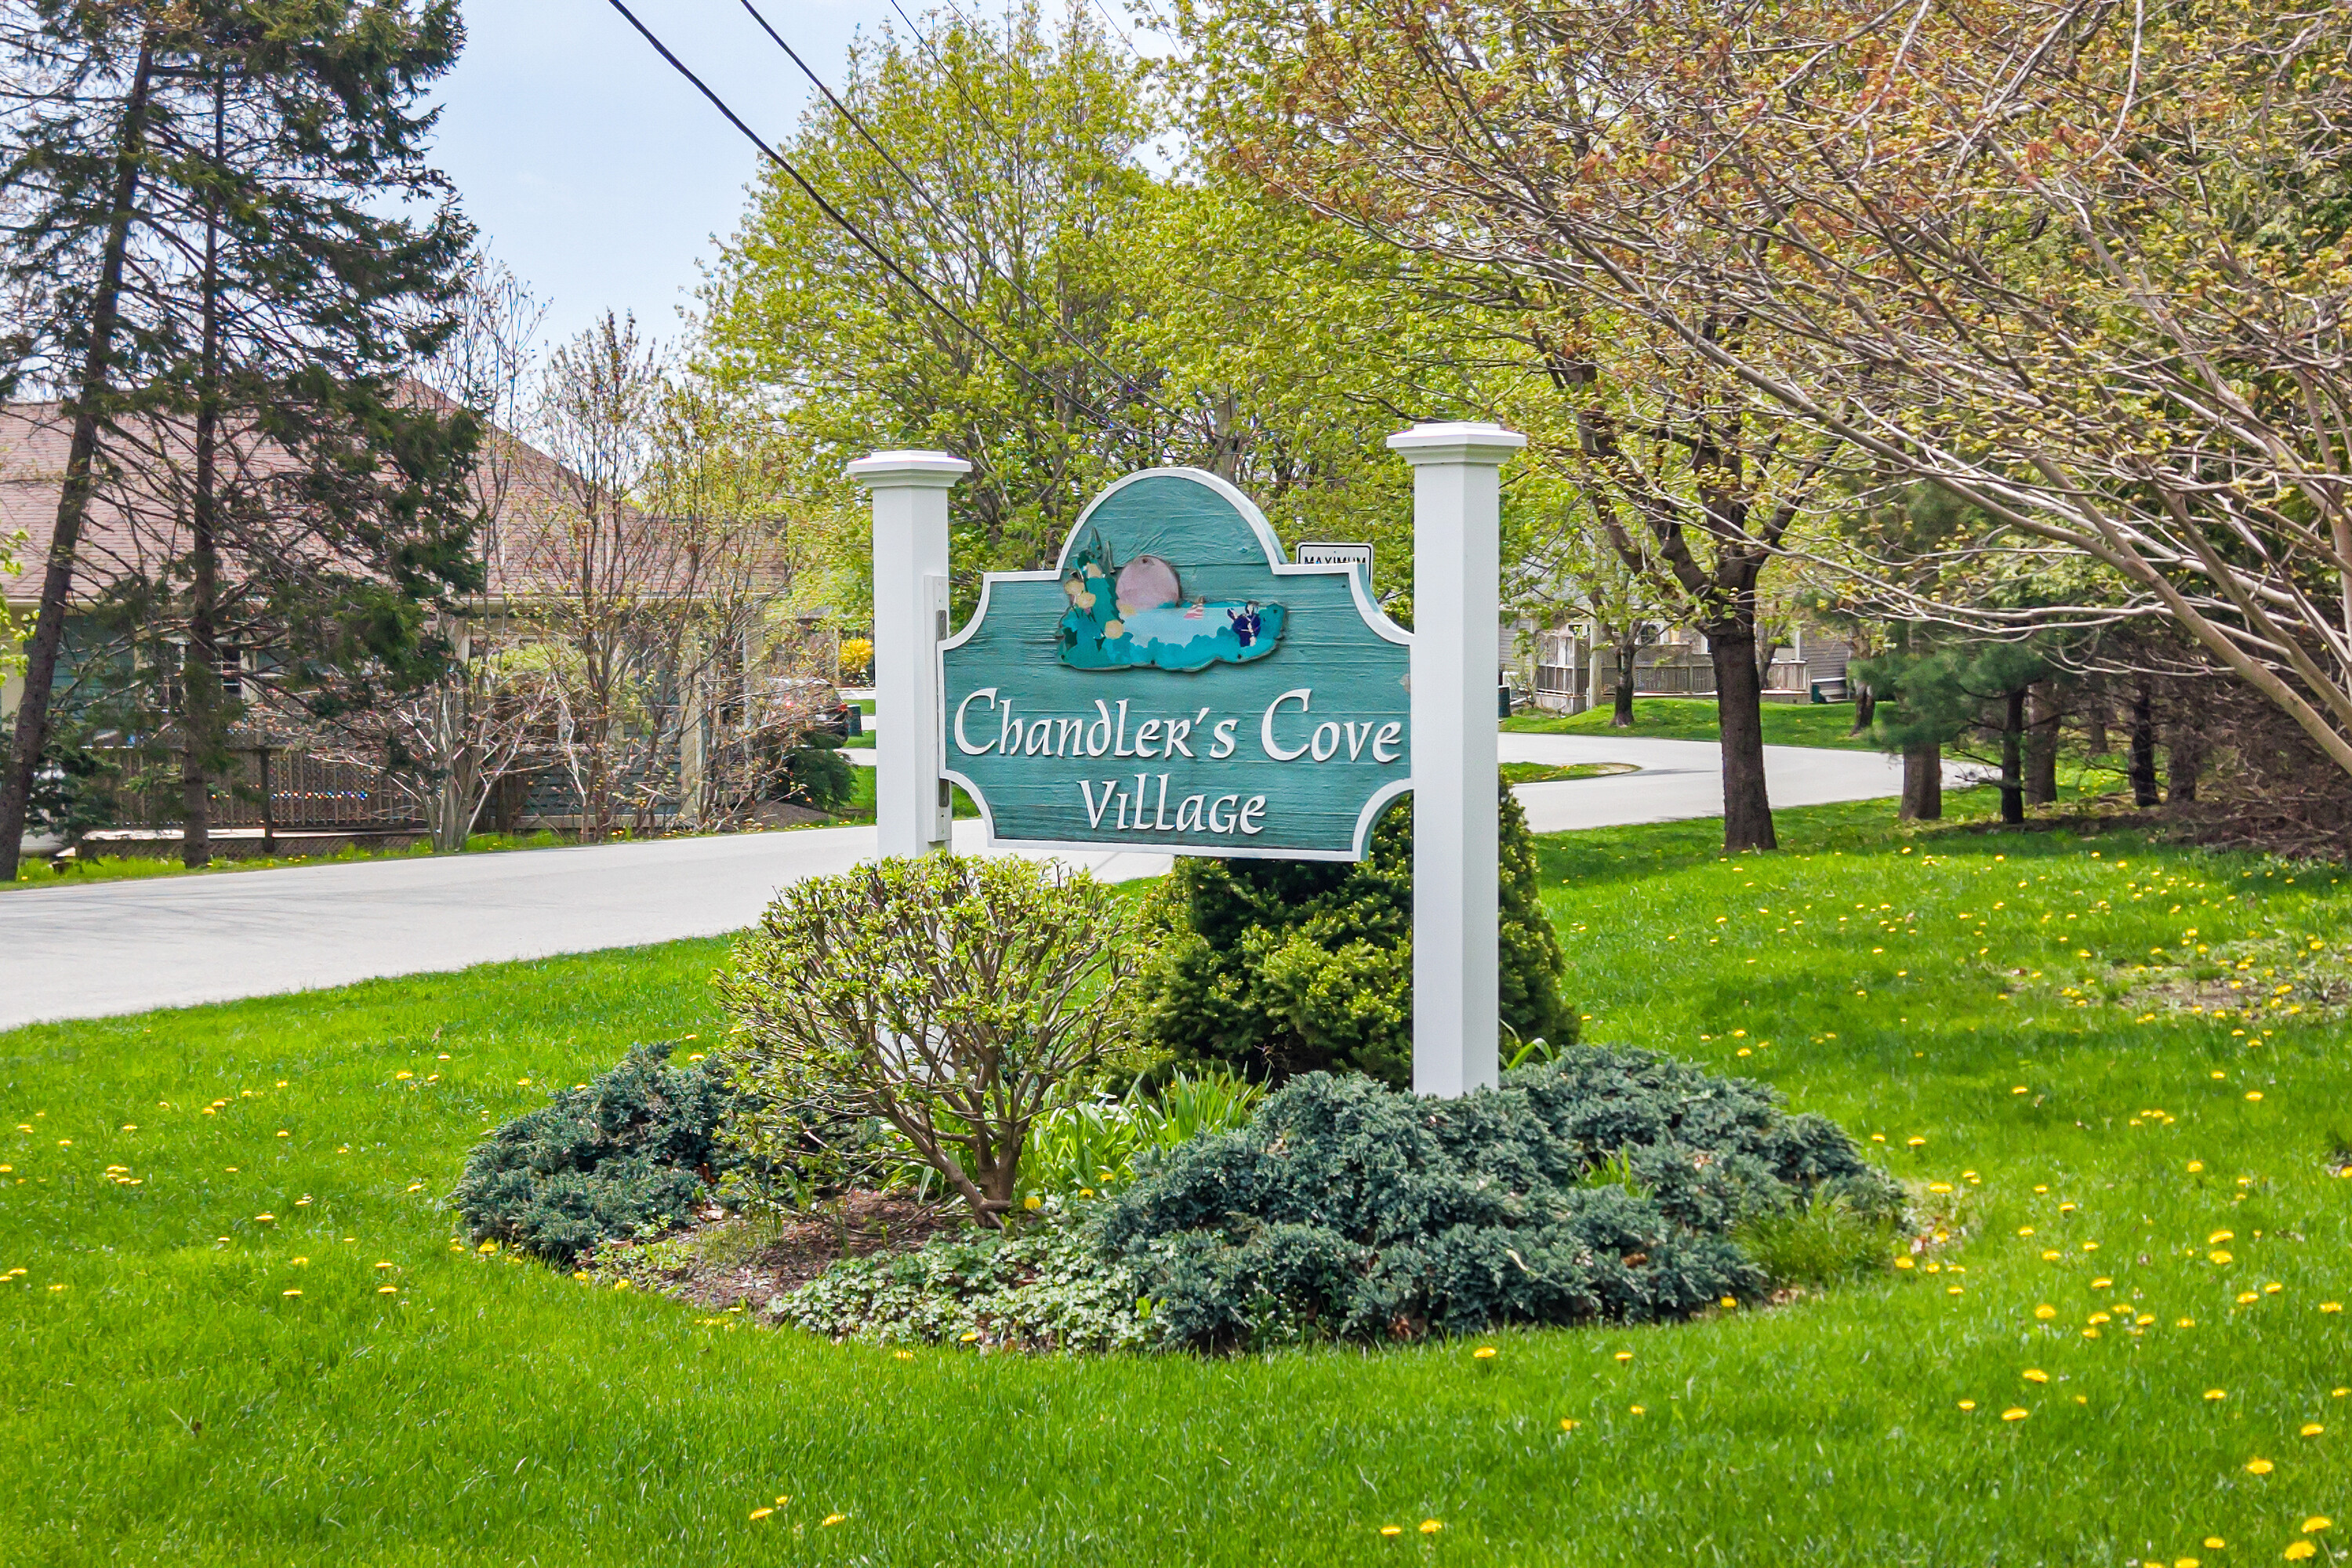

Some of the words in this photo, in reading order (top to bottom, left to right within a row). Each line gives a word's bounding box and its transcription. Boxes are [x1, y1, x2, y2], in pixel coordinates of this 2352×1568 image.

[954, 688, 1239, 759] Chandler's
[1261, 688, 1402, 763] Cove
[1077, 773, 1266, 834] Village
